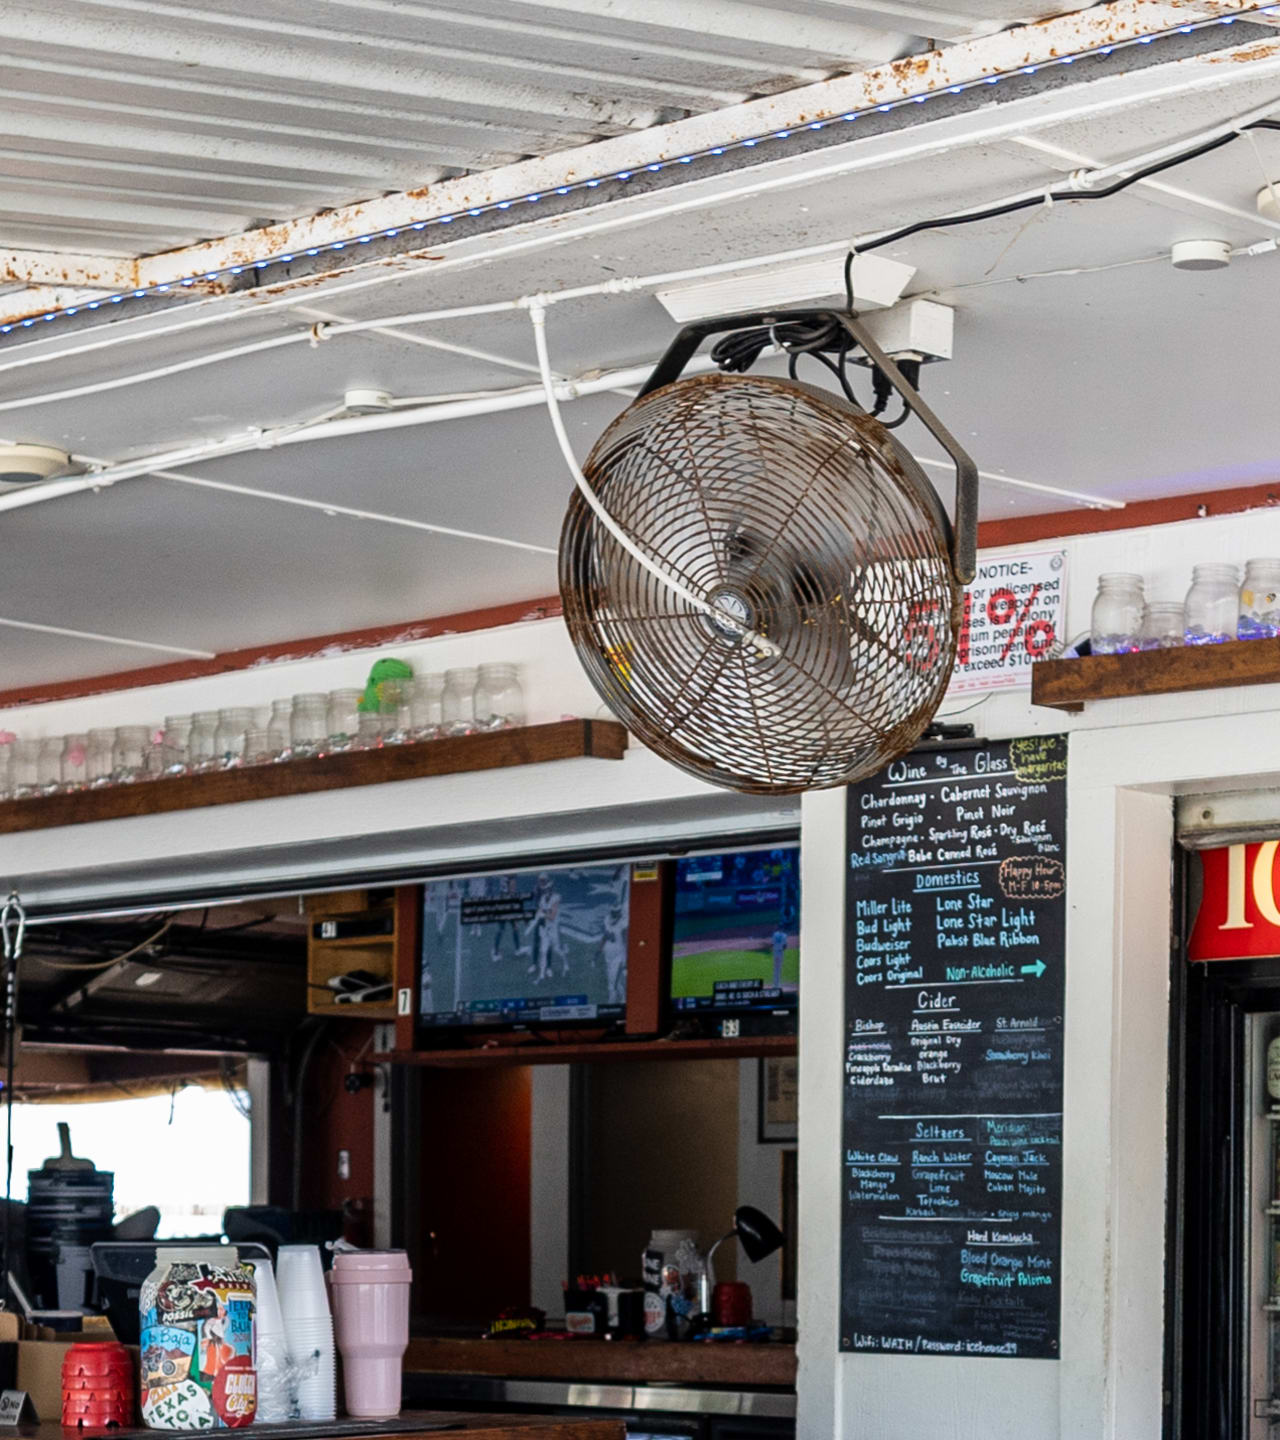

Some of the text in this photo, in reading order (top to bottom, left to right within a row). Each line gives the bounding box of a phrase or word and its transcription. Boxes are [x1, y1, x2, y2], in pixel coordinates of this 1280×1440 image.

[979, 562, 1032, 579] NOTICE-
[973, 578, 1059, 599] or unlicensed
[979, 602, 986, 612] a
[990, 597, 1039, 611] weapon
[1044, 594, 1060, 605] on
[990, 615, 999, 625] is
[1016, 609, 1055, 622] felony
[994, 622, 1057, 642] penalty of
[958, 638, 1028, 659] prisonment
[964, 658, 1004, 672] exceed
[889, 761, 927, 781] Wine
[950, 764, 967, 775] The
[975, 752, 1007, 772] Glass
[861, 783, 1047, 810] Chardonnay Cabernet Sauvignon
[861, 805, 1015, 830] Pinot Grigio Pinot Noir
[916, 871, 979, 889] Domestics
[1003, 865, 1059, 880] Happy Hour
[856, 894, 994, 917] Miller Lite Lone Star
[857, 908, 1035, 937] Bud Light Lone Star Light
[856, 932, 1040, 952] Budweiser Pabst Blue Ribbon
[856, 954, 911, 970] Coors Light
[857, 963, 1014, 985] Coors Original Non-Alcoholic
[401, 991, 407, 1012] 7
[918, 991, 956, 1009] Cider
[911, 1036, 961, 1049] Original Dry
[922, 1073, 947, 1084] Brut
[916, 1123, 964, 1138] Seltzers
[912, 1169, 965, 1184] Grapefruit
[987, 1183, 1045, 1195] Cuban Mojito
[961, 1250, 1052, 1271] Blood Orange Mint
[961, 1269, 1051, 1287] Grapefruit Paloma
[162, 1310, 194, 1321] FOSSIL
[160, 1329, 191, 1349] Baja
[148, 1385, 198, 1422] TEXAS
